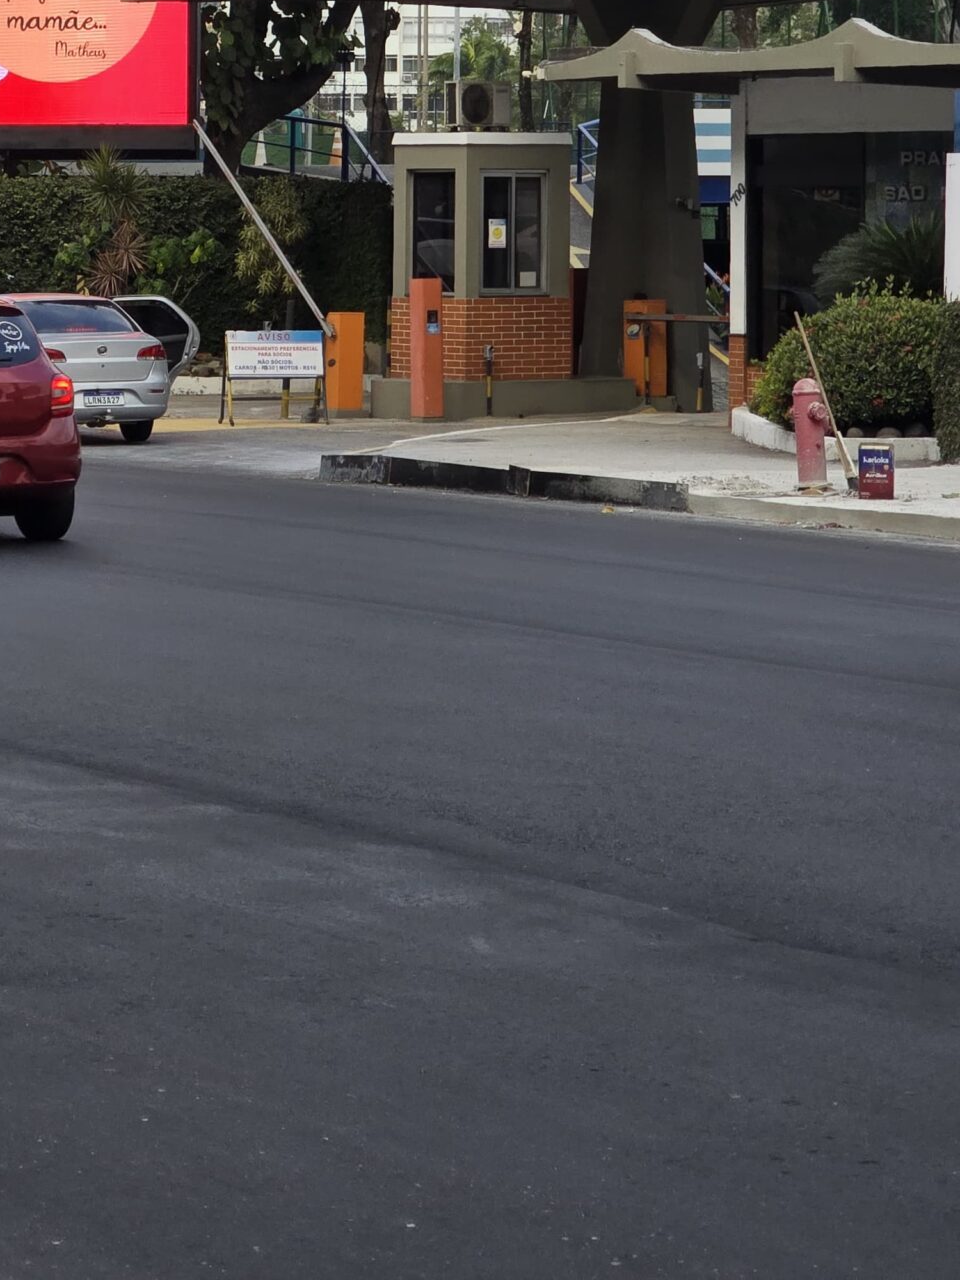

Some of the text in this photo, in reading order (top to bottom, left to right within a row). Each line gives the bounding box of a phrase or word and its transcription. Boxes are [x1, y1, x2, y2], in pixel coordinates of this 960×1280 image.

[7, 10, 107, 31] mamãe...
[55, 40, 106, 59] Matheus
[257, 333, 291, 341] AVISO
